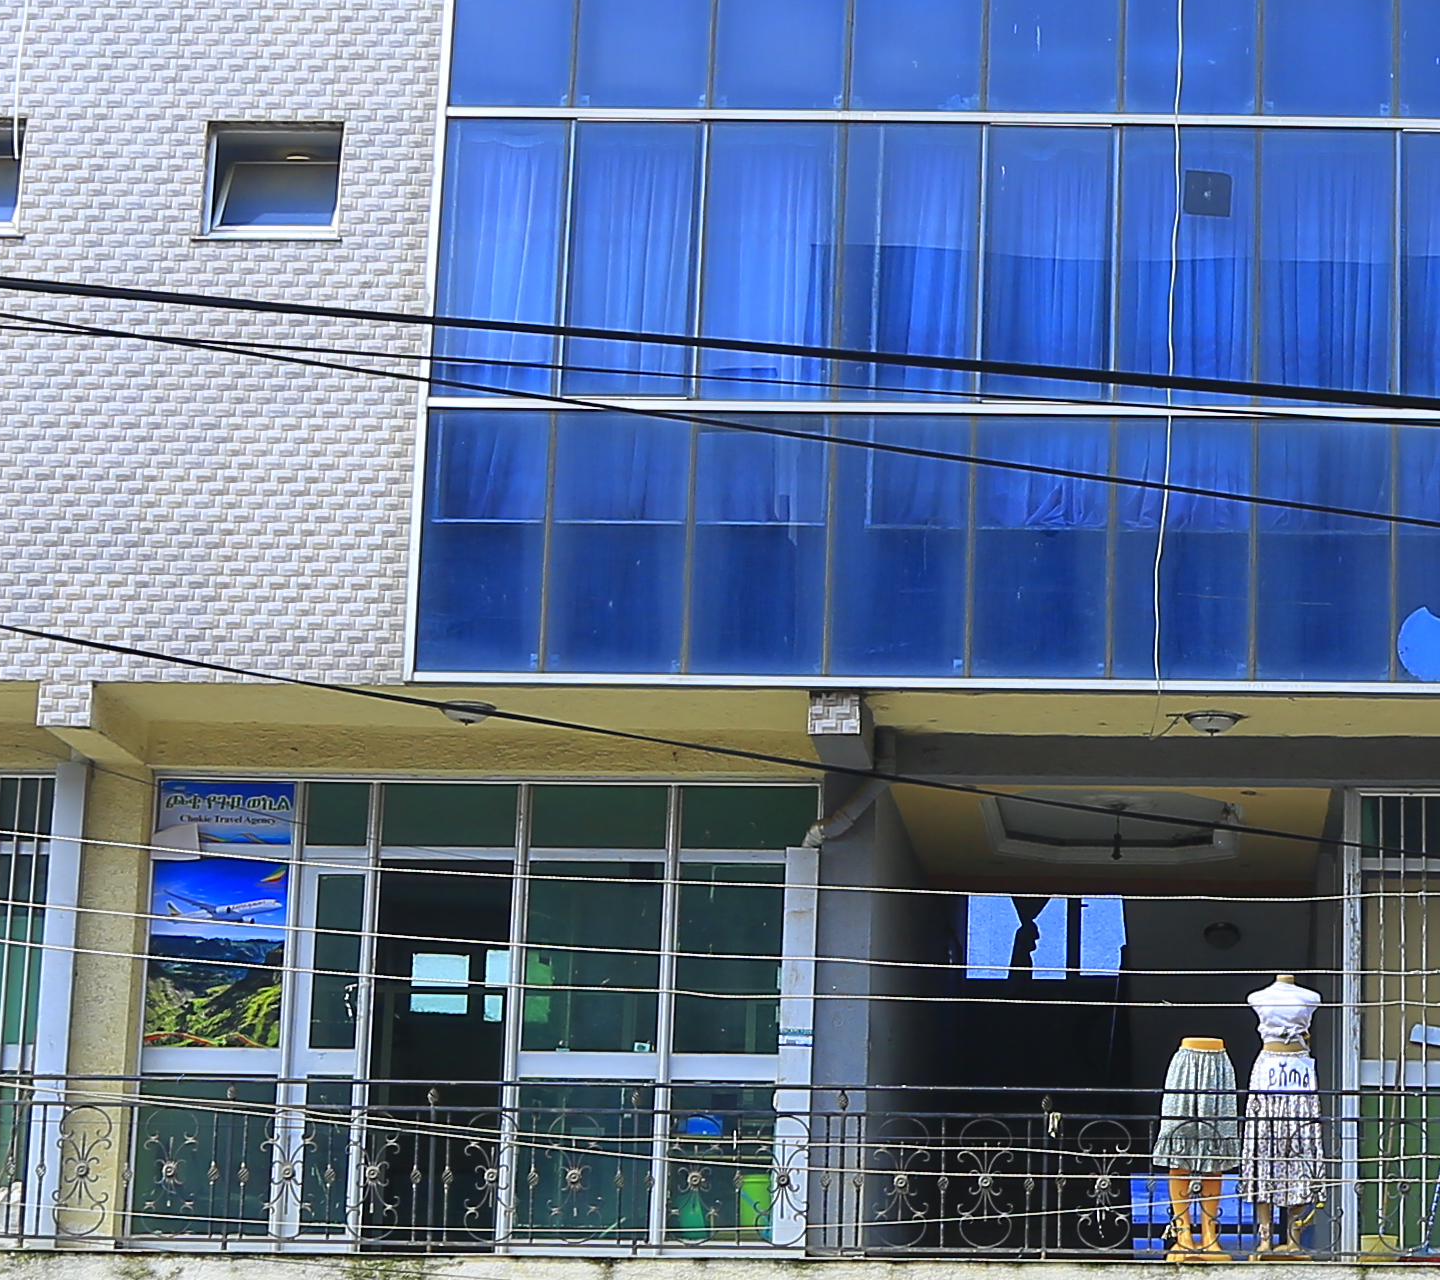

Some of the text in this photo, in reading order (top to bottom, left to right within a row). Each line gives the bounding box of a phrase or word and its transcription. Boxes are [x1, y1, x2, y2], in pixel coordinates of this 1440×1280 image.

[180, 814, 277, 826] Chokie Travel Agency
